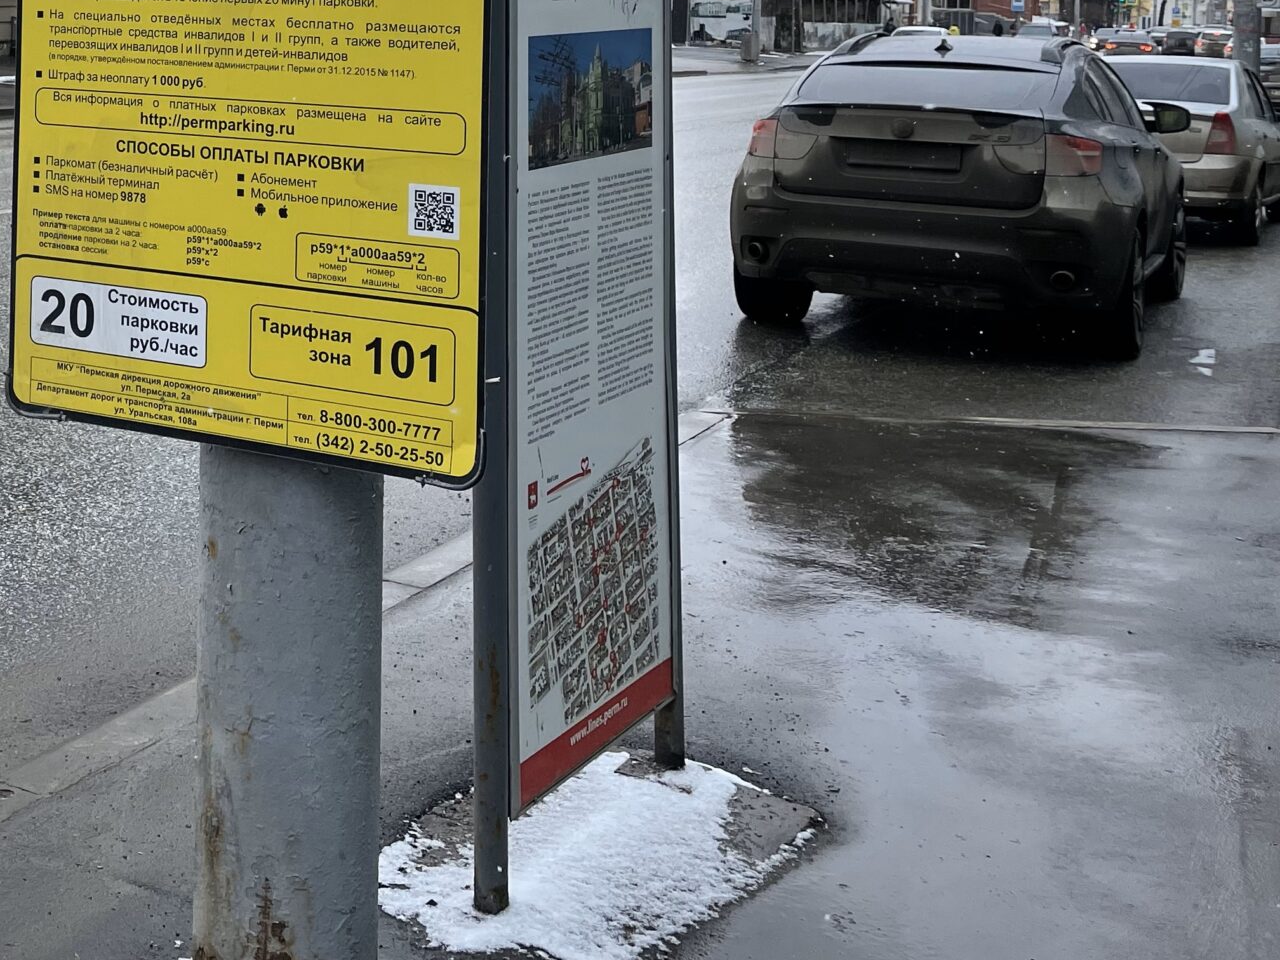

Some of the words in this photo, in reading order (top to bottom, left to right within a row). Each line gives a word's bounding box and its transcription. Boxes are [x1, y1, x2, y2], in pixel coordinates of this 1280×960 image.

[49, 8, 64, 20] На
[73, 11, 141, 23] специально
[150, 13, 221, 26] отведённых
[231, 17, 275, 28] местах
[285, 16, 354, 31] бесплатно
[365, 22, 461, 35] размещаются
[48, 24, 123, 38] транспортные
[127, 28, 178, 40] средства
[183, 30, 245, 43] инвалидов
[261, 33, 269, 42] и
[287, 34, 324, 47] групп,
[330, 36, 338, 46] а
[344, 37, 381, 48] также
[387, 38, 460, 52] водителей,
[48, 38, 118, 52] перевозящих
[119, 42, 179, 54] инвалидов
[185, 45, 193, 54] и
[202, 45, 234, 58] групп
[235, 47, 243, 56] и
[243, 46, 348, 63] детей-инвалидов
[48, 52, 56, 62] (в
[56, 53, 89, 63] порядке,
[89, 55, 146, 64] утверждённом
[146, 57, 214, 69] постановлением
[214, 61, 280, 73] администрации
[286, 62, 316, 75] Перми
[316, 66, 327, 74] от
[327, 65, 377, 77] 31.12.2015
[376, 67, 389, 77] №
[48, 68, 85, 83] Штраф
[86, 72, 98, 82] за
[99, 73, 150, 87] неоплату
[181, 76, 207, 90] руб.
[52, 90, 72, 102] Вся
[74, 92, 143, 108] информация
[152, 99, 160, 108] о
[168, 100, 217, 112] платных
[226, 103, 286, 116] парковках
[296, 108, 366, 122] размещена
[377, 113, 393, 124] на
[404, 113, 442, 127] сайте
[140, 111, 295, 137] http://permparking.ru
[115, 138, 195, 158] СПОСОБЫ
[199, 145, 269, 164] ОПЛАТЫ
[273, 151, 364, 172] ПАРКОВКИ
[44, 168, 105, 185] Платёжный
[106, 176, 160, 190] терминал
[45, 154, 97, 169] Паркомат
[97, 159, 174, 176] (безналичный
[174, 168, 218, 183] расчёт)
[250, 171, 318, 188] Абонемент
[44, 182, 69, 196] SMS
[70, 188, 83, 198] на
[84, 189, 119, 203] номер
[119, 190, 146, 204] 9878
[250, 186, 319, 205] Мобильное
[320, 196, 398, 212] приложение
[32, 207, 63, 220] Пример
[64, 212, 90, 222] текста
[90, 215, 107, 224] для
[108, 217, 141, 227] машины
[142, 220, 148, 228] с
[148, 221, 186, 232] номером
[306, 271, 348, 284] парковки
[318, 261, 347, 273] номер
[366, 266, 396, 279] номер
[416, 272, 447, 283] кол-во
[361, 277, 400, 289] машины
[415, 284, 444, 294] часов
[39, 288, 95, 338] 20
[107, 288, 199, 314] Стоимость
[120, 314, 198, 336] парковки
[258, 316, 351, 344] Тарифная
[130, 336, 198, 357] руб./час
[308, 349, 351, 366] зона
[364, 336, 439, 383] 101
[56, 361, 74, 372] МКУ
[120, 373, 162, 386] дирекция
[162, 379, 211, 393] дорожного
[120, 383, 133, 392] ул.
[135, 384, 179, 400] Пермская,
[180, 391, 191, 401] 2а
[35, 381, 89, 398] Департамент
[89, 392, 115, 402] дорог
[123, 397, 173, 412] транспорта
[174, 405, 244, 423] администрации
[253, 416, 284, 430] Перми
[113, 406, 126, 415] ул.
[128, 406, 176, 424] Уральская,
[177, 415, 197, 426] 108а
[296, 412, 316, 422] тел.
[319, 409, 441, 441] 8-800-300-7777
[293, 434, 313, 445] тел.
[316, 432, 355, 456] (342)
[358, 439, 444, 467] 2-50-25-50
